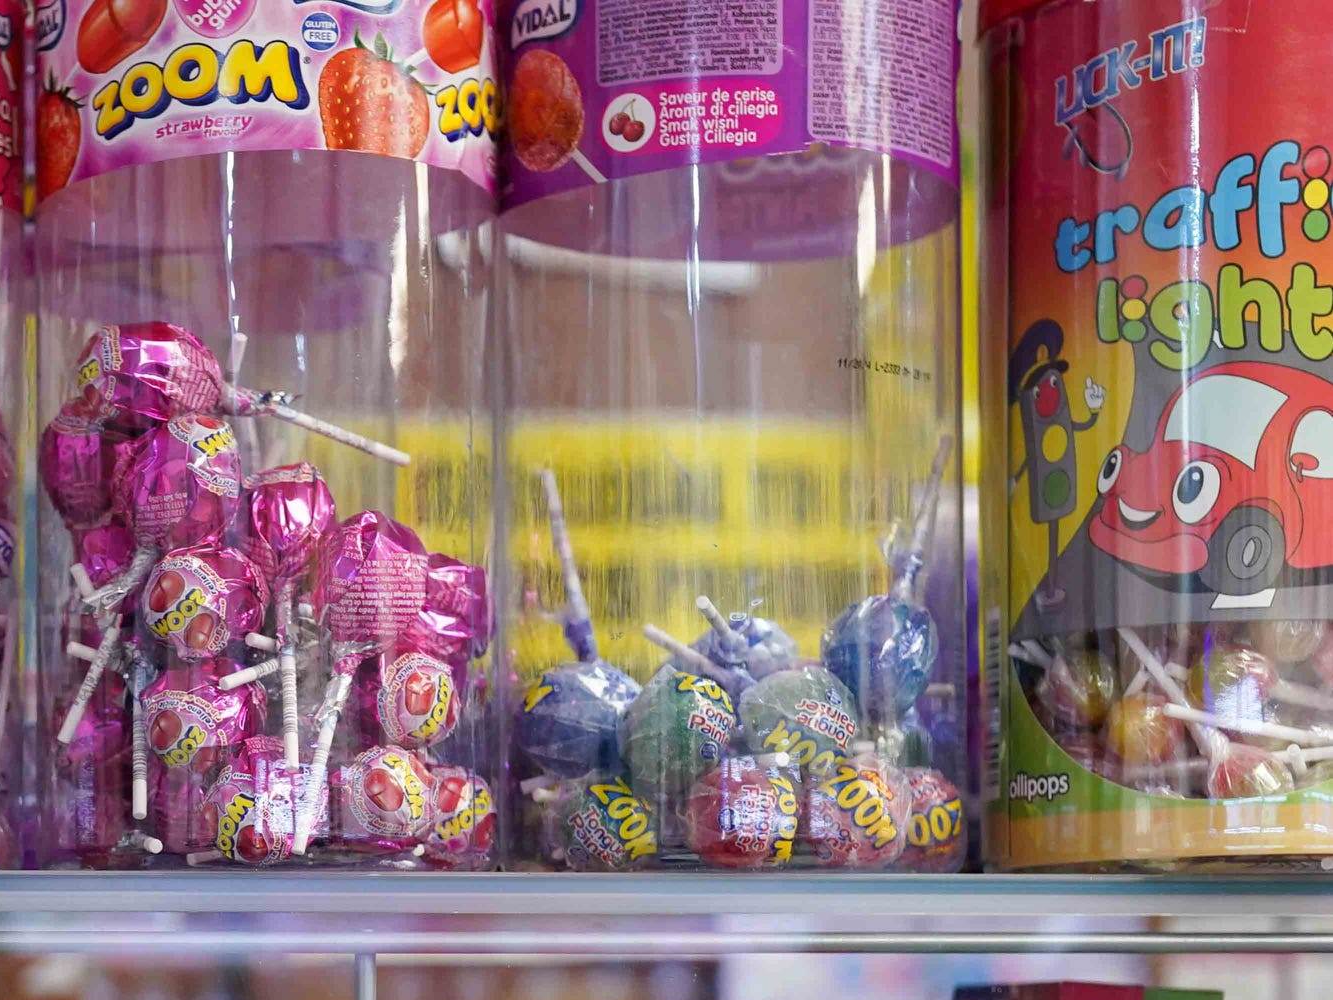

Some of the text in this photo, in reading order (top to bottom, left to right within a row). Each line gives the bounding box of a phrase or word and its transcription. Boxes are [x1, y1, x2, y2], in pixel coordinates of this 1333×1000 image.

[305, 20, 336, 29] GLUTEN
[513, 0, 571, 34] VIDAL
[309, 32, 332, 41] FREE
[93, 39, 306, 139] ZOOM
[659, 87, 775, 106] Saveur de cerise
[659, 101, 778, 120] Aroma di ciliegia
[156, 115, 252, 139] strawberry
[202, 127, 241, 138] flavour
[659, 114, 739, 133] Smak wiśni
[659, 128, 757, 147] Gusto Ciliegia
[1054, 140, 1333, 273] traffi
[825, 767, 897, 849] ZOOM
[590, 777, 660, 860] ZOOM
